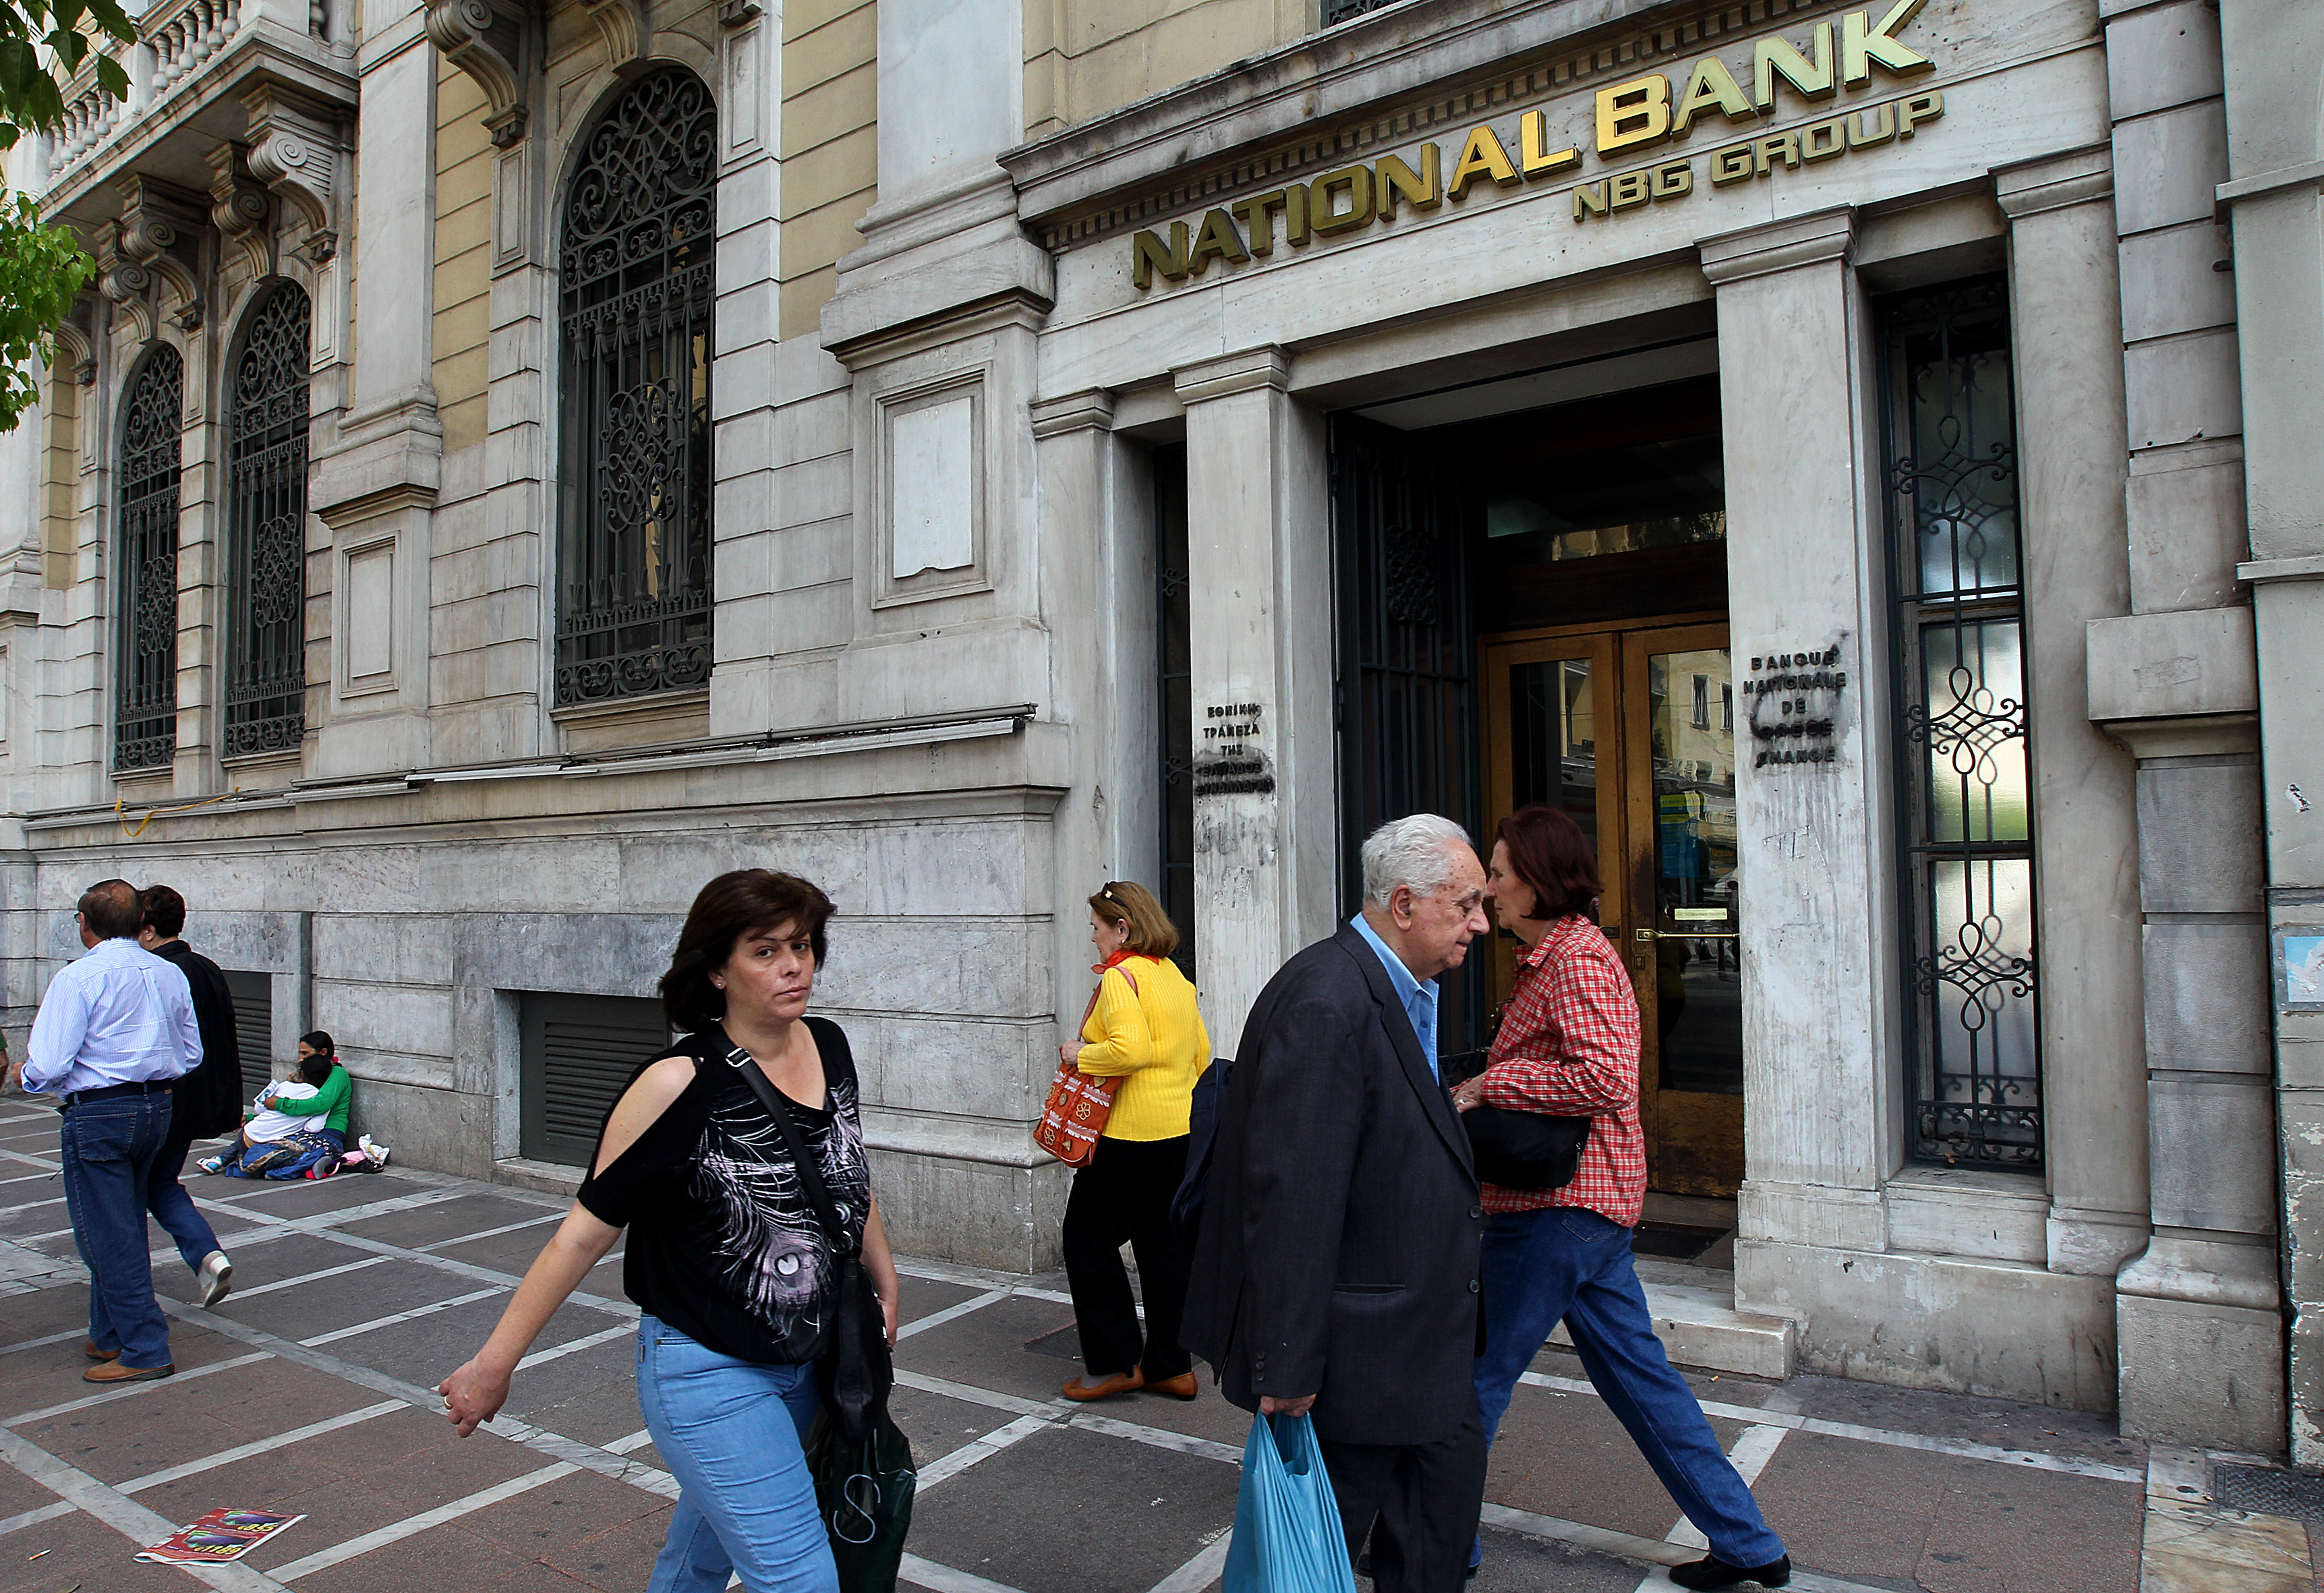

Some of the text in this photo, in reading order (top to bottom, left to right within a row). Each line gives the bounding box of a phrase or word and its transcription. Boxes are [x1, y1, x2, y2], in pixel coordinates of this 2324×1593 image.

[1133, 0, 1936, 290] NATIONAL BANK
[1572, 90, 1944, 222] NBG GROUP
[1751, 650, 1836, 670] BANQUE
[1743, 672, 1847, 694] NATIONALE
[1207, 703, 1258, 718] ΕΘΝΙΚΗ
[1782, 698, 1807, 714] DE
[1203, 724, 1259, 738] ΤΡΑΠΕΖΑ
[1221, 744, 1243, 756] ΤΗΣ
[1758, 747, 1836, 764] CHANGE
